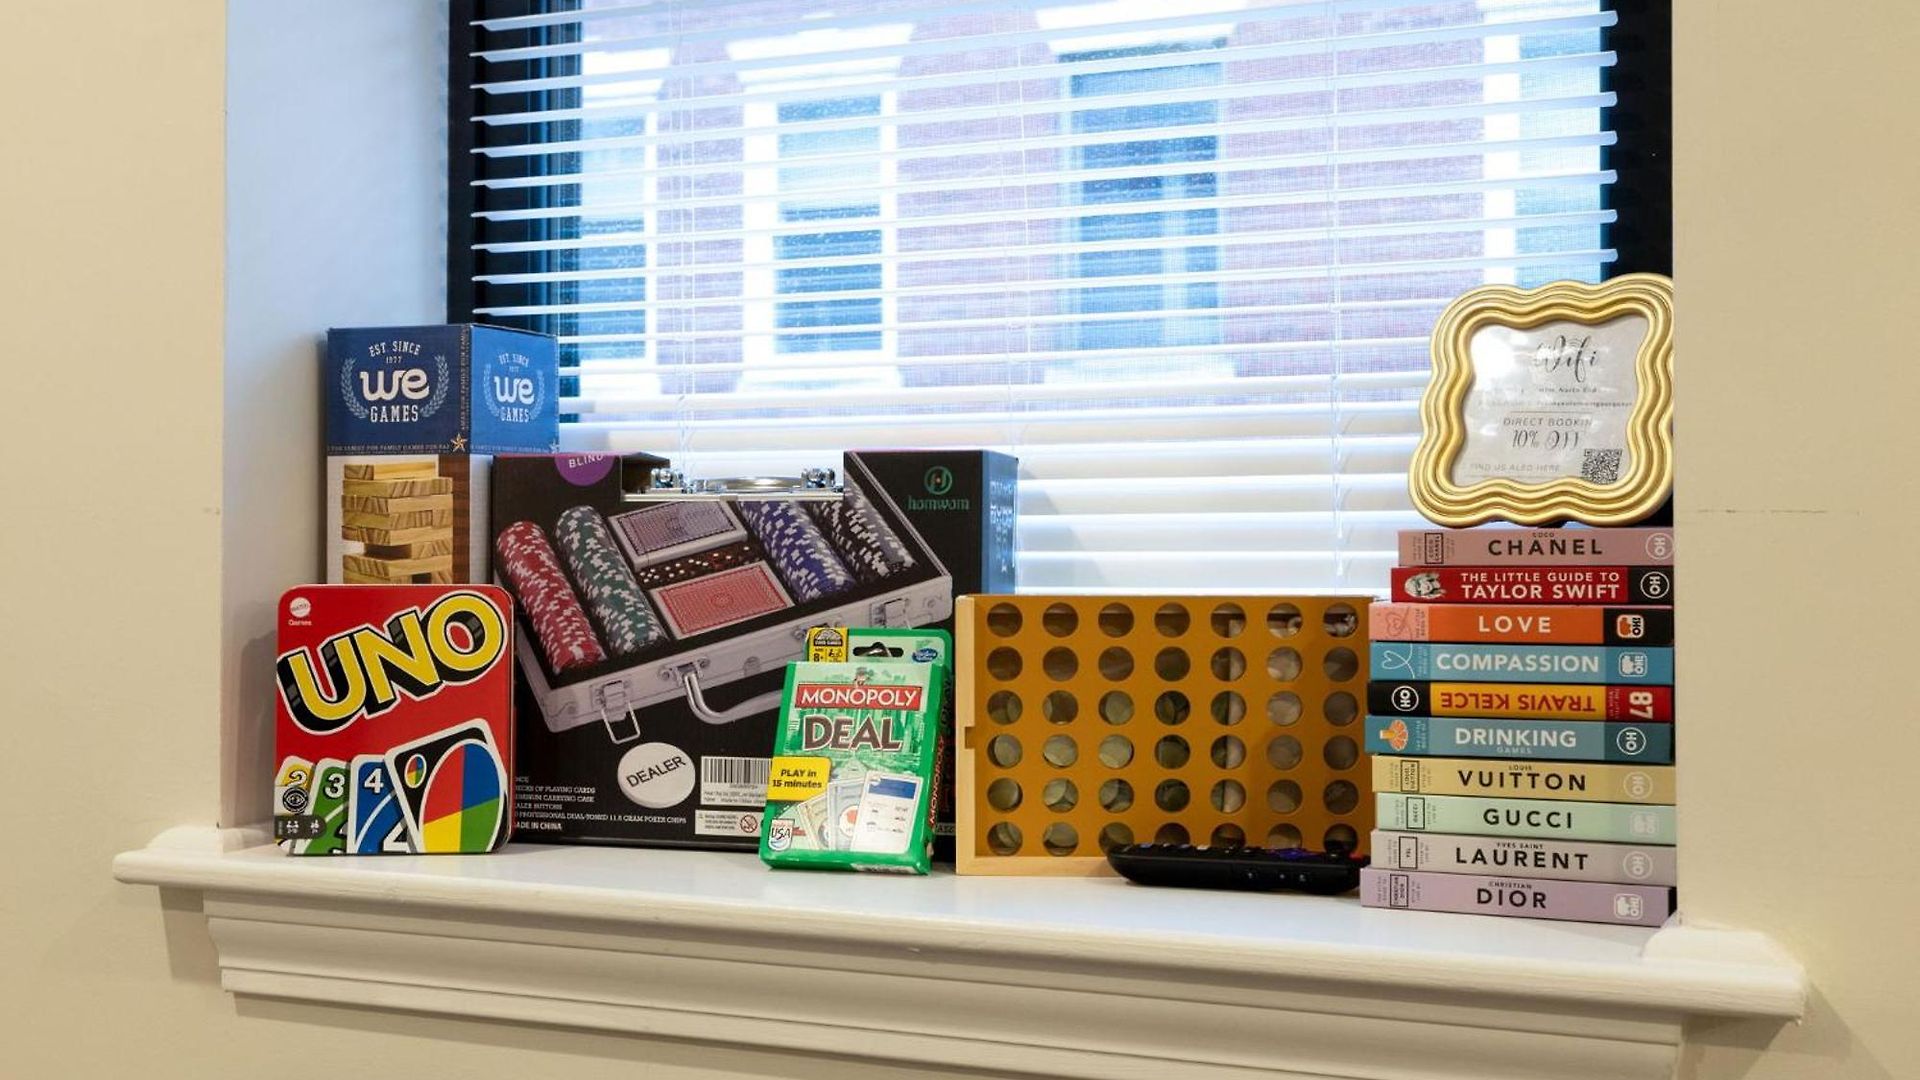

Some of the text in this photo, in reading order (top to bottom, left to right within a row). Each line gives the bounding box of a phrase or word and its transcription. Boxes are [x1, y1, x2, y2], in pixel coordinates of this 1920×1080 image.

[369, 340, 421, 357] EST SINCE
[360, 368, 430, 401] we
[494, 376, 535, 405] we
[370, 404, 418, 423] GAMES
[500, 406, 530, 423] GAMES
[1503, 418, 1592, 427] DIRECT BOOKIN
[1512, 430, 1538, 448] 10%
[1488, 539, 1603, 556] CHANEL
[1461, 572, 1620, 583] THE LITTLE GUIDE TO
[1461, 584, 1620, 599] TAYLOR SWIFT
[1478, 615, 1552, 633] LOVE
[276, 590, 507, 735] UNO
[1436, 653, 1599, 673] COMPASSION
[801, 688, 917, 706] MONOPOLY
[1441, 692, 1510, 709] KELCE
[1518, 694, 1596, 712] TRAVIS
[1629, 691, 1653, 720] 87
[803, 714, 903, 752] DEAL
[1455, 727, 1577, 748] DRINKING
[289, 770, 307, 788] 2
[364, 767, 384, 793] 4
[626, 756, 686, 787] DEALER
[781, 769, 817, 778] PLAY in
[929, 735, 944, 824] MONOPOLY
[1458, 770, 1586, 791] VUITTON
[325, 773, 346, 798] 3
[772, 779, 822, 789] 15 minutes
[516, 821, 562, 830] ADE IN CHINA
[1483, 809, 1572, 829] GUCCI
[772, 827, 791, 840] USA
[1456, 847, 1588, 870] LAURENT
[1489, 881, 1532, 889] CHRISTIAN
[1477, 888, 1547, 909] DIOR
